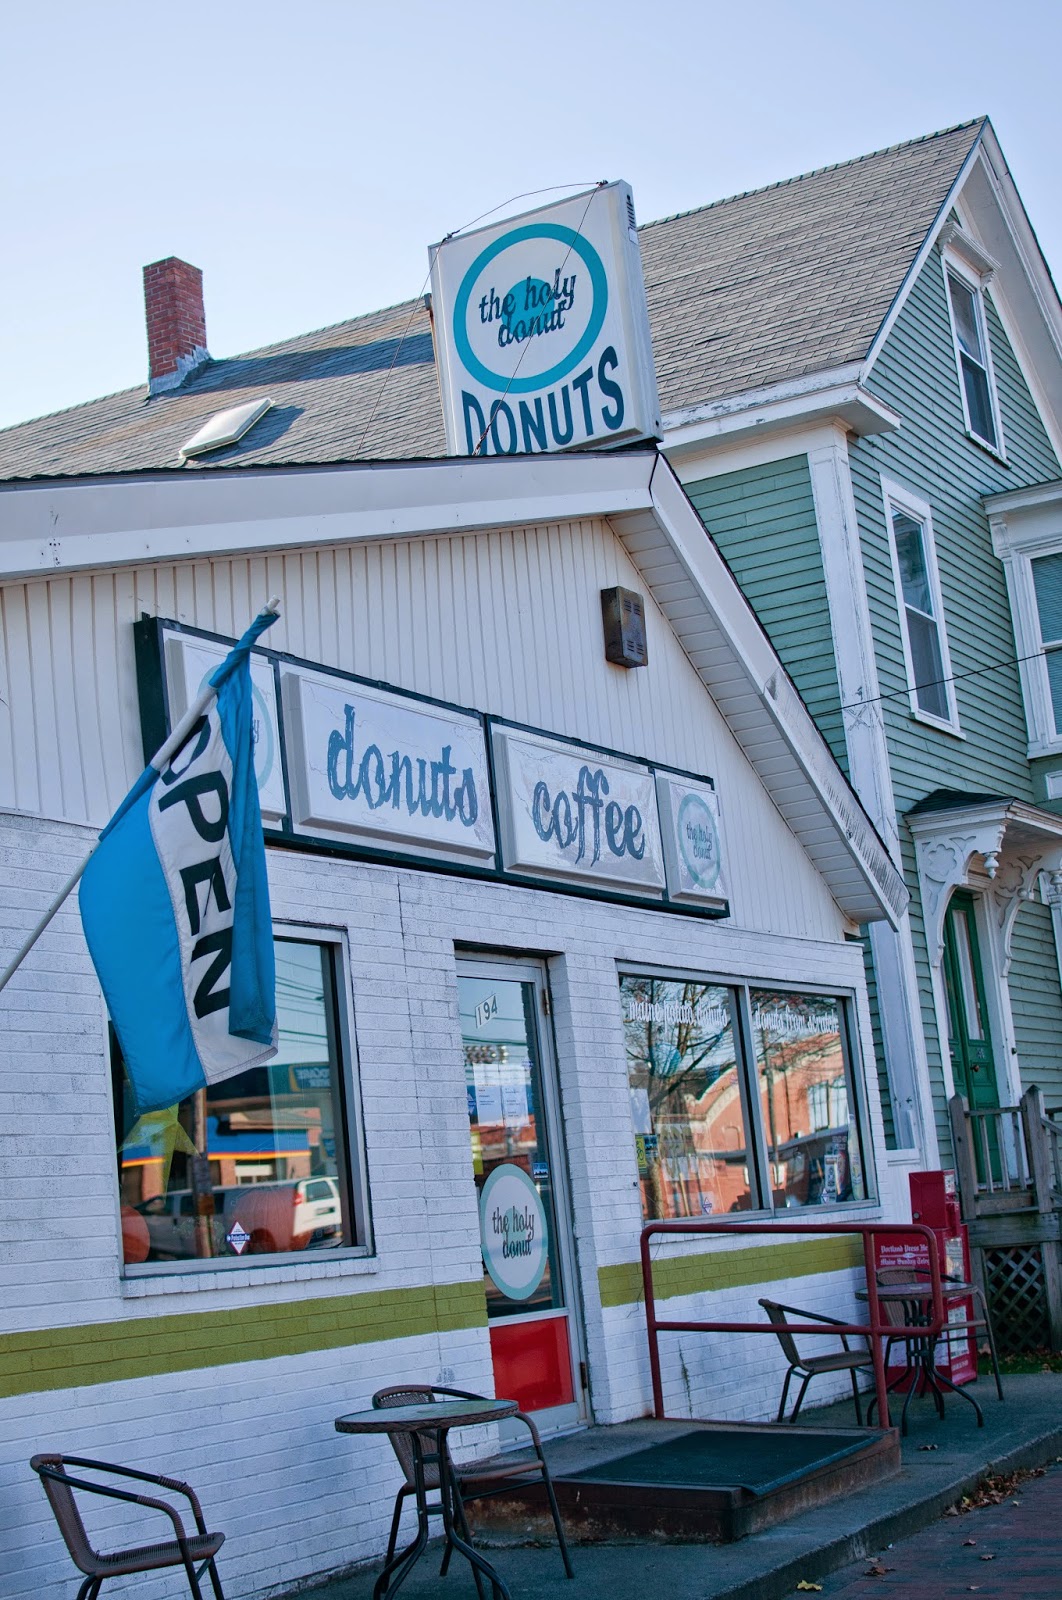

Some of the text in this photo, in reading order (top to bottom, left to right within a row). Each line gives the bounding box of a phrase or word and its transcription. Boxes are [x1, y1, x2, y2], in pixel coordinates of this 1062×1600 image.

[478, 267, 577, 324] the holy
[498, 299, 566, 348] donut
[461, 344, 625, 456] DONUTS
[326, 703, 478, 827] donuts
[532, 765, 645, 867] coffee
[686, 821, 697, 841] the
[477, 995, 498, 1026] 194
[629, 995, 661, 1022] maine
[696, 998, 728, 1028] donuts
[755, 1002, 784, 1034] donuts
[785, 1004, 806, 1033] from
[492, 1205, 535, 1241] the holy
[502, 1231, 532, 1259] donut
[880, 1245, 904, 1254] Portland
[904, 1244, 920, 1253] Press
[880, 1258, 896, 1266] Maine
[896, 1257, 916, 1267] Sunday
